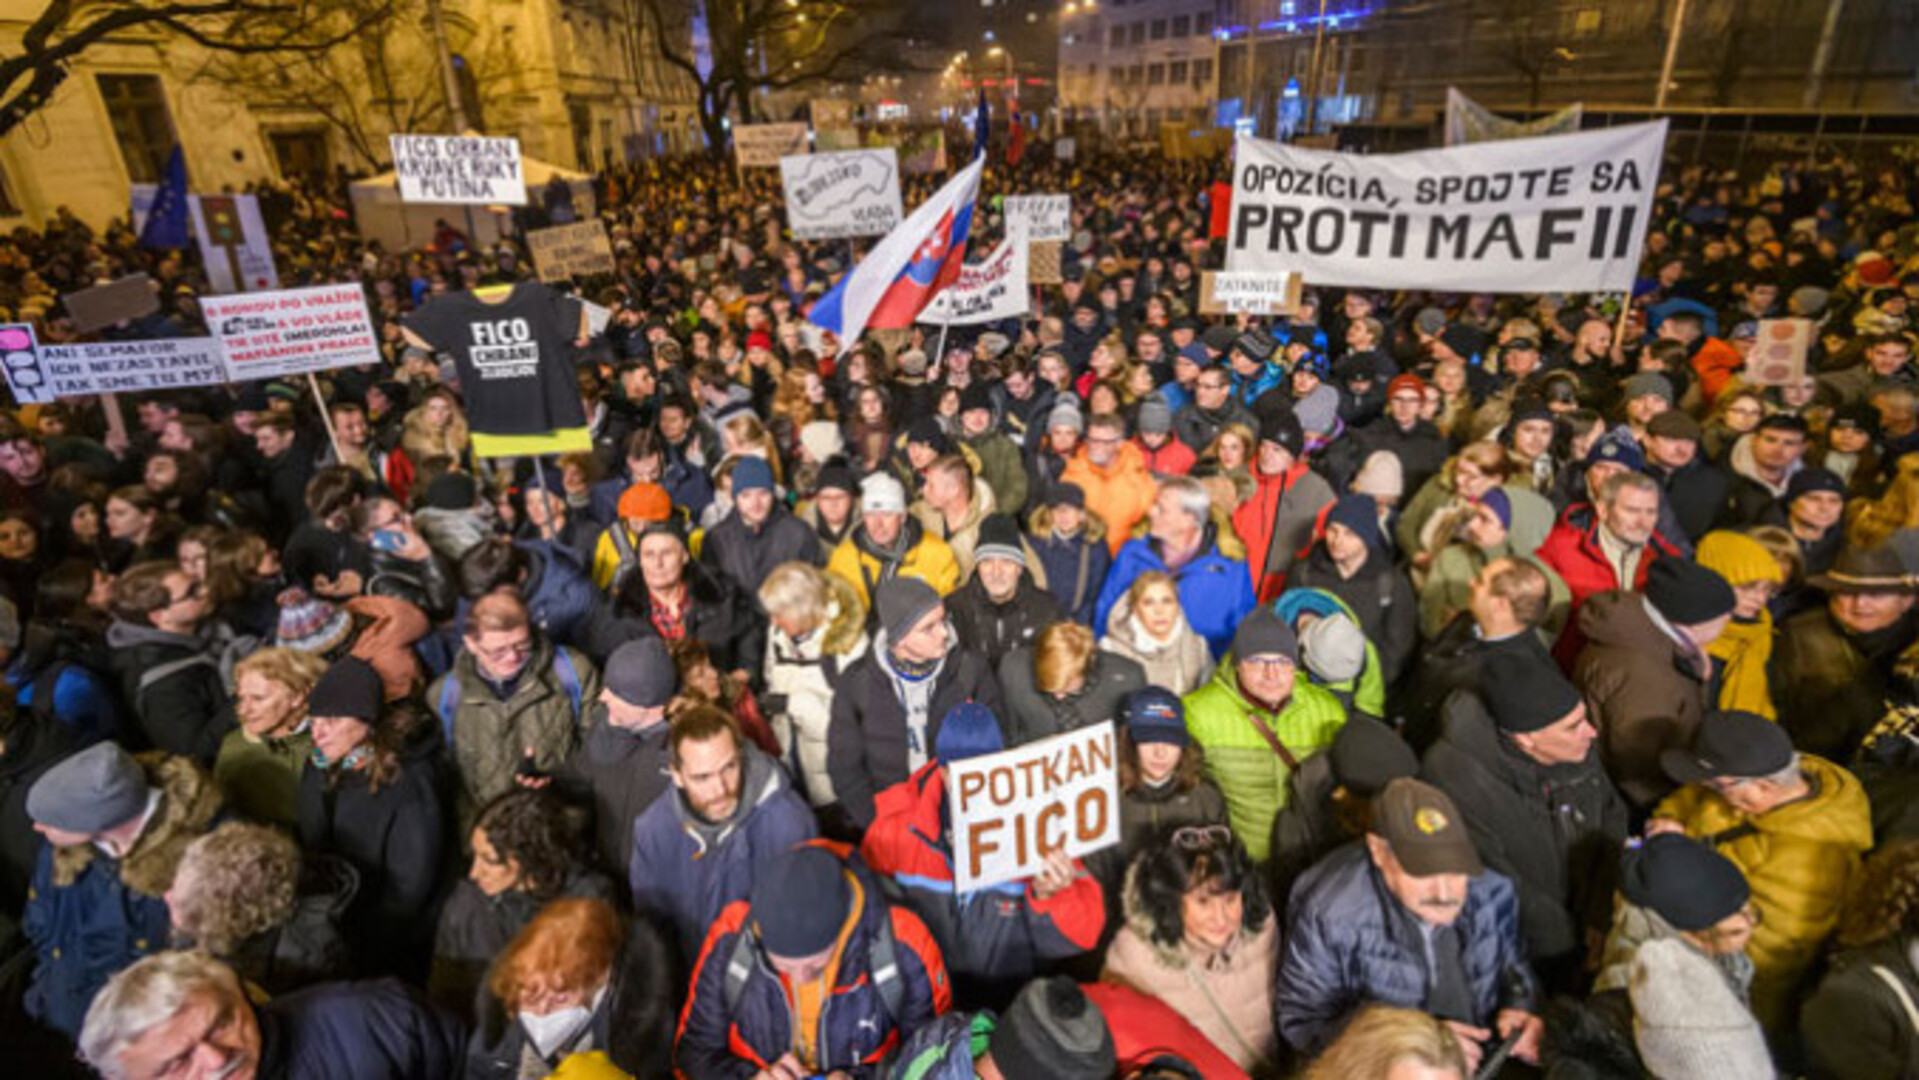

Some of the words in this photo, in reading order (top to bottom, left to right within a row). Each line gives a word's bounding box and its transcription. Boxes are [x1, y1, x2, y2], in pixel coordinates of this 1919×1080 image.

[1241, 162, 1399, 208] OPOZÍCIA,
[1415, 166, 1574, 205] SPOJTE
[1590, 159, 1642, 194] SA
[1234, 204, 1409, 258] PROTI
[1425, 205, 1638, 260] MAFII
[470, 317, 530, 345] FICO
[960, 732, 1111, 813] POTKAN
[968, 787, 1108, 880] FICO
